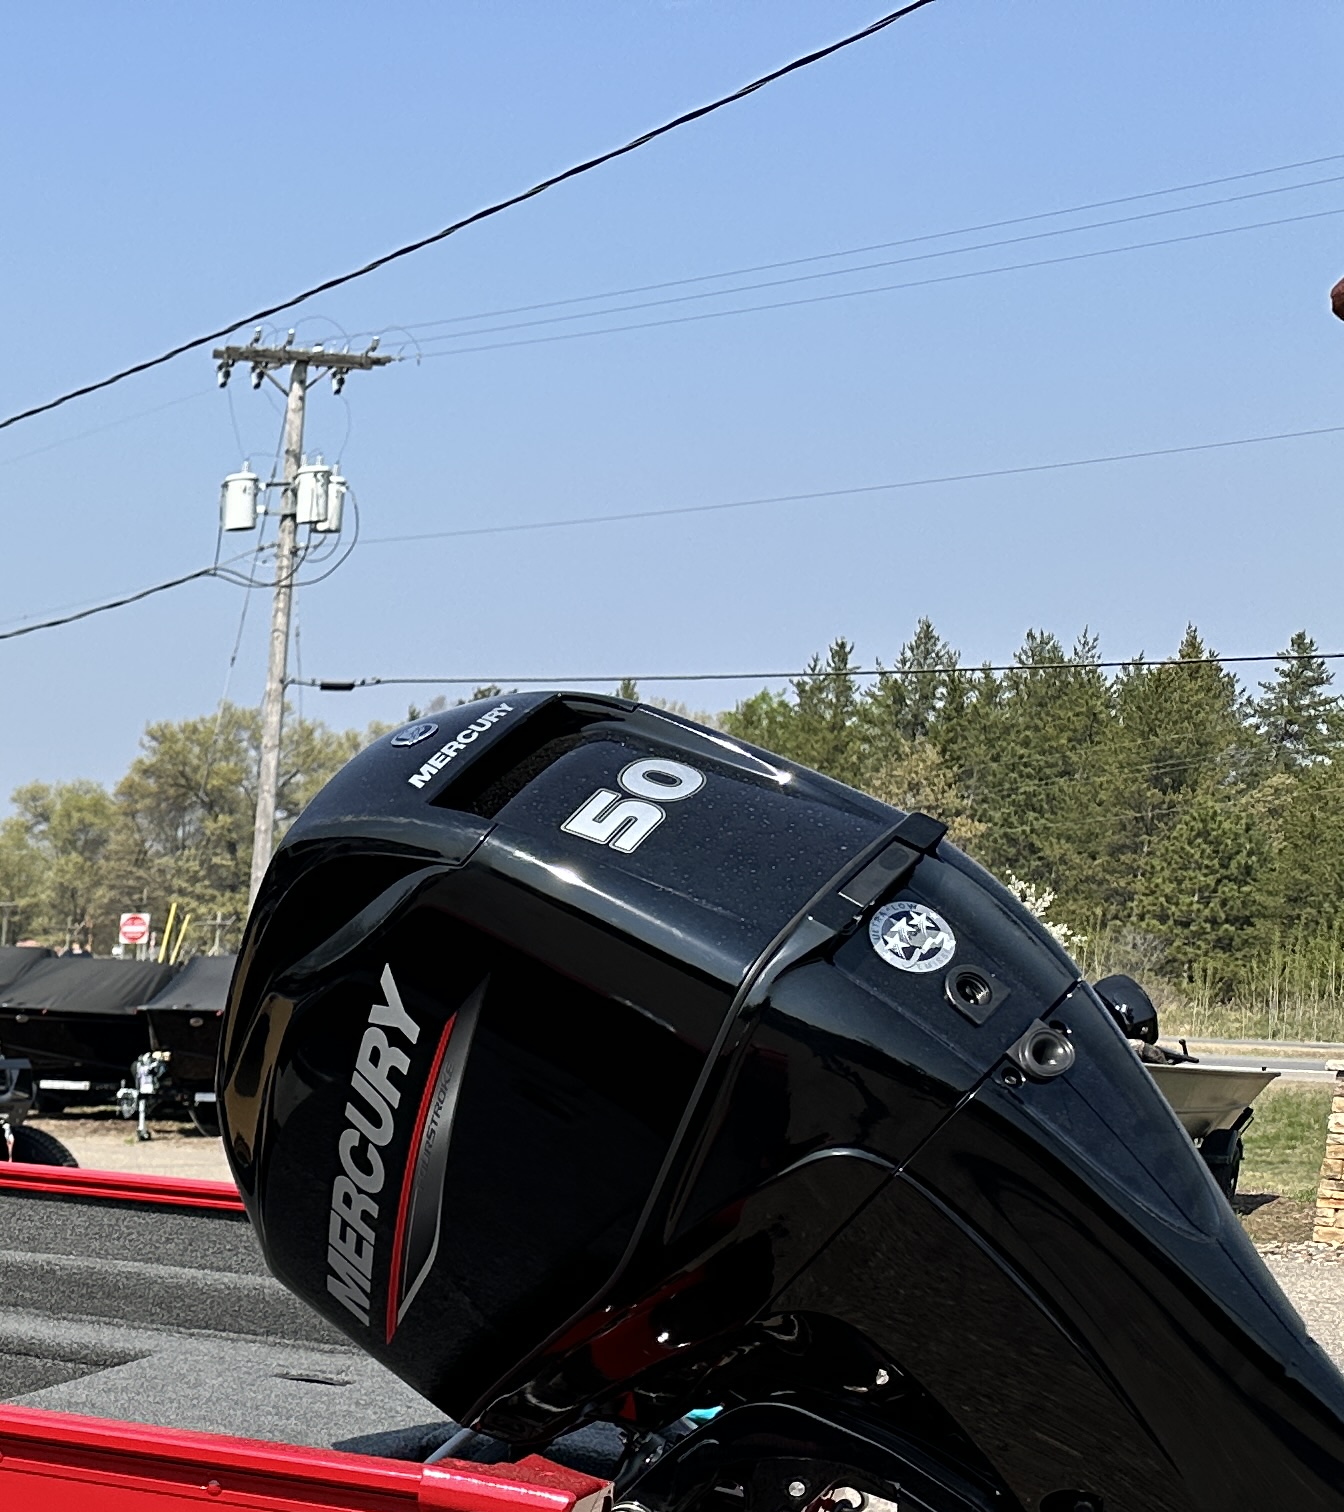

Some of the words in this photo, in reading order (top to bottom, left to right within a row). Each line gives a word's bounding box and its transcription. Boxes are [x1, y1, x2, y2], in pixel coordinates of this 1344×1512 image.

[408, 702, 514, 789] MERCURY
[560, 757, 707, 854] 50
[326, 963, 421, 1327] MERCURY
[416, 1060, 455, 1192] FOURSTROKE
